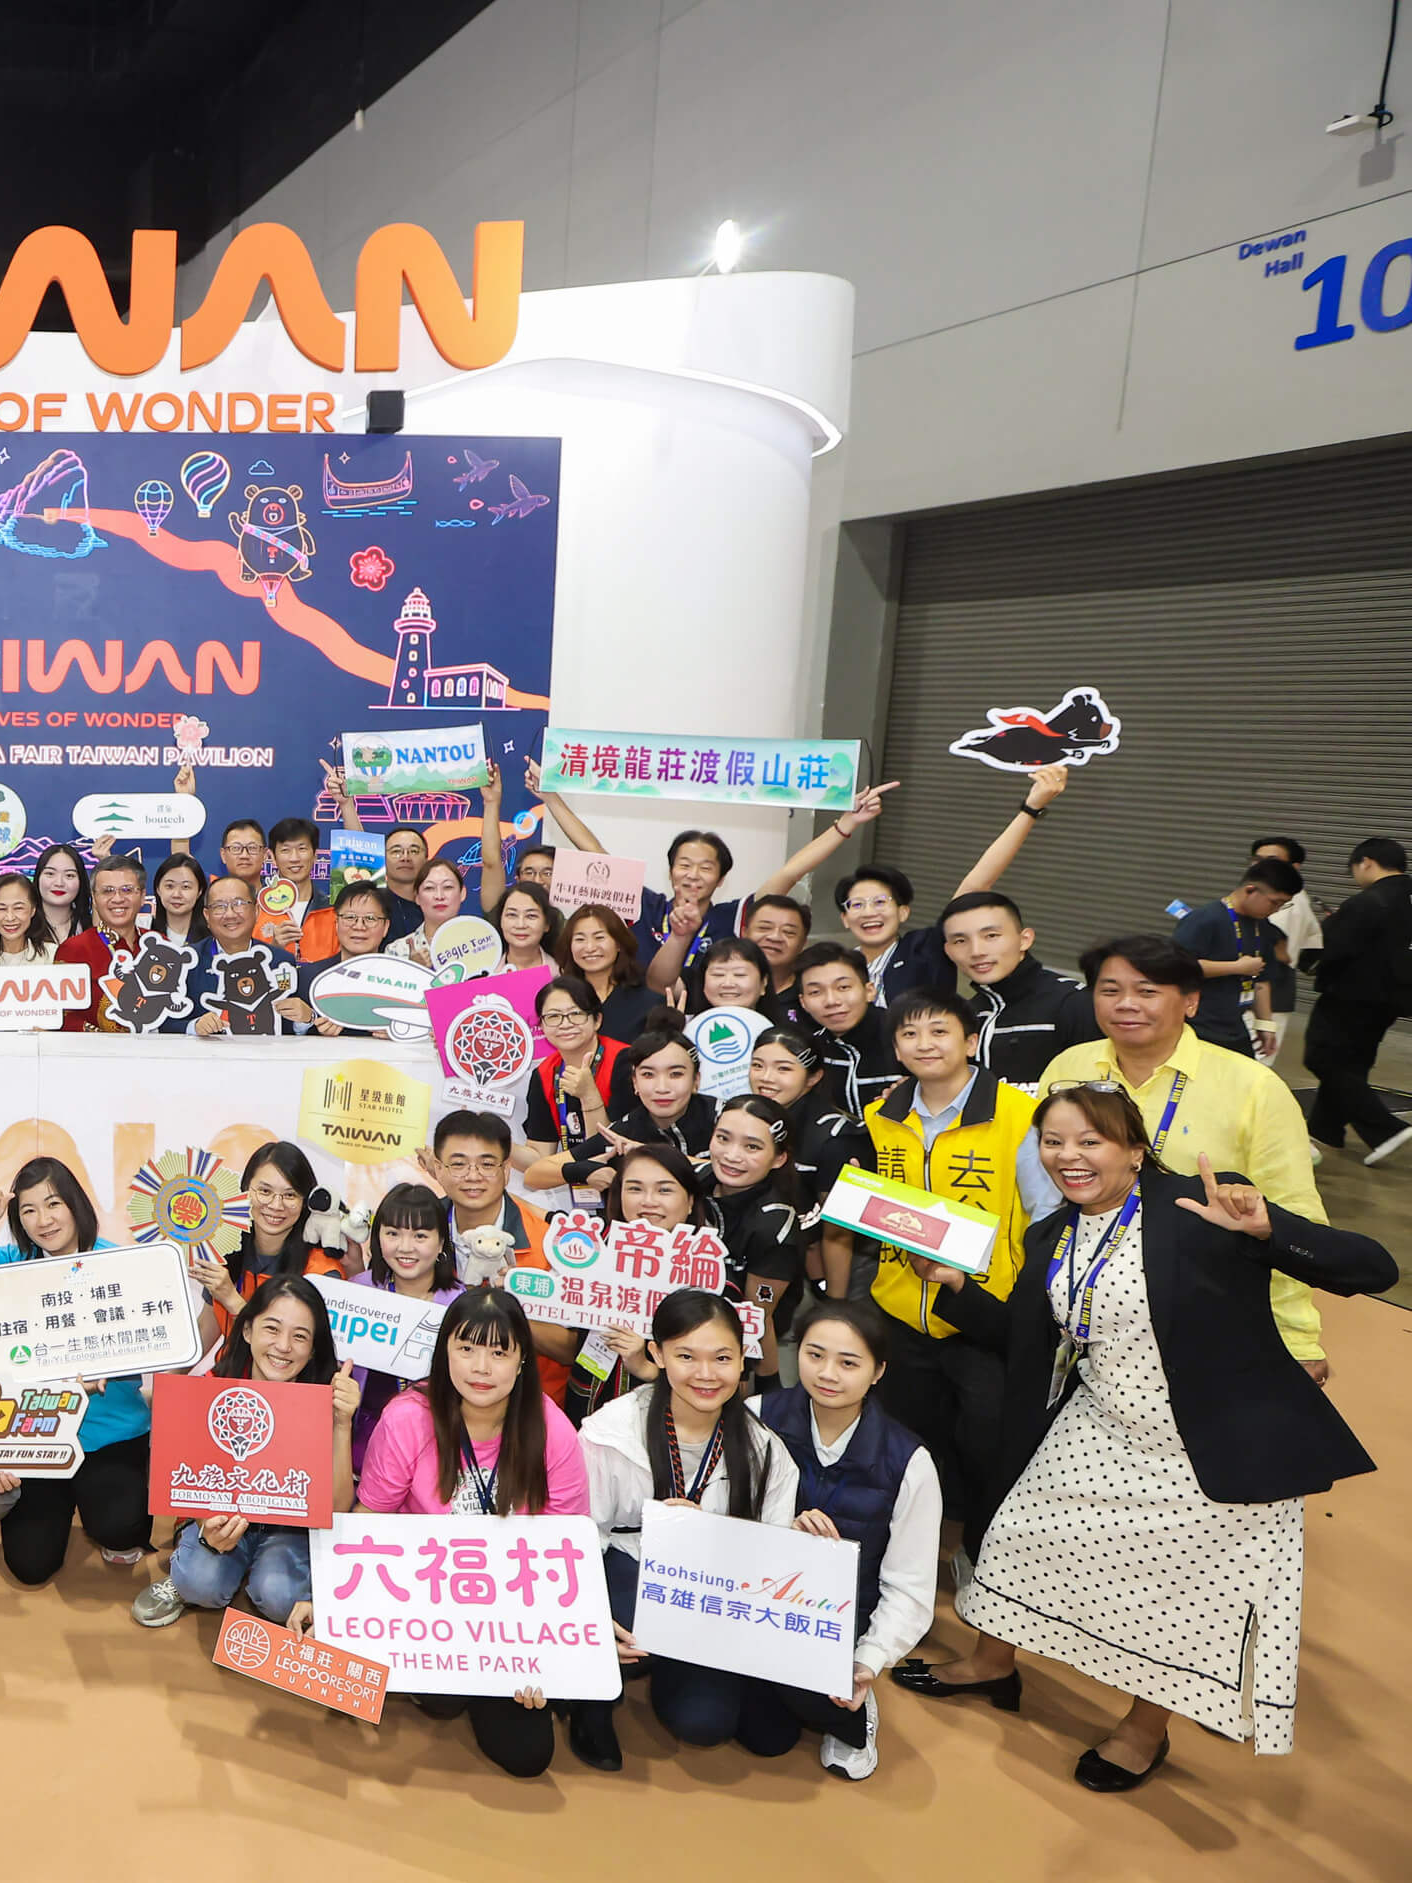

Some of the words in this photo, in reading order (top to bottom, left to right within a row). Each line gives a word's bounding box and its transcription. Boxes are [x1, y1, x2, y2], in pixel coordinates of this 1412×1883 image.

[1238, 230, 1307, 260] Dewan
[1264, 252, 1304, 278] Hall
[1294, 238, 1412, 351] 10
[86, 391, 335, 432] WONDER
[46, 711, 78, 727] OF
[10, 745, 64, 766] FAIR
[66, 746, 159, 767] TAIWAN
[163, 747, 274, 768] PAVILION
[395, 743, 476, 765] NANTOU
[560, 743, 831, 791] 清境龍莊渡假山莊
[553, 895, 571, 904] New
[555, 882, 637, 905] 牛耳藝術渡假村
[436, 943, 470, 966] Eagle
[470, 935, 493, 947] Tour
[367, 975, 393, 987] EVA
[395, 980, 417, 991] AIR
[0, 1009, 13, 1018] OF
[14, 1008, 59, 1018] WONDER
[448, 1084, 511, 1107] 九族文化村
[358, 1102, 377, 1111] STAR
[378, 1105, 404, 1115] HOTEL
[321, 1123, 402, 1147] TAIWAN
[615, 1223, 725, 1291] 帝綸
[514, 1274, 552, 1297] 東埔
[524, 1302, 570, 1322] OTEL
[34, 1325, 168, 1357] 台一生態休閒農場
[64, 1349, 110, 1364] Ecological
[112, 1345, 146, 1357] Leisure
[147, 1341, 171, 1351] Farm
[21, 1389, 83, 1414] Taiwan
[10, 1412, 61, 1437] Farm
[16, 1449, 34, 1459] FUN
[35, 1449, 58, 1459] STAY
[170, 1462, 312, 1498] 九族文化村
[171, 1489, 232, 1502] FORMOSAN
[238, 1493, 307, 1510] ABORIGINAL
[333, 1535, 585, 1608] 六福村
[641, 1581, 843, 1643] 高雄信宗大飯店
[327, 1616, 454, 1642] LEOFOO
[465, 1620, 601, 1647] VILLAGE
[388, 1652, 469, 1672] THEME
[479, 1656, 542, 1675] PARK
[275, 1654, 379, 1703] LEOFOORESORT
